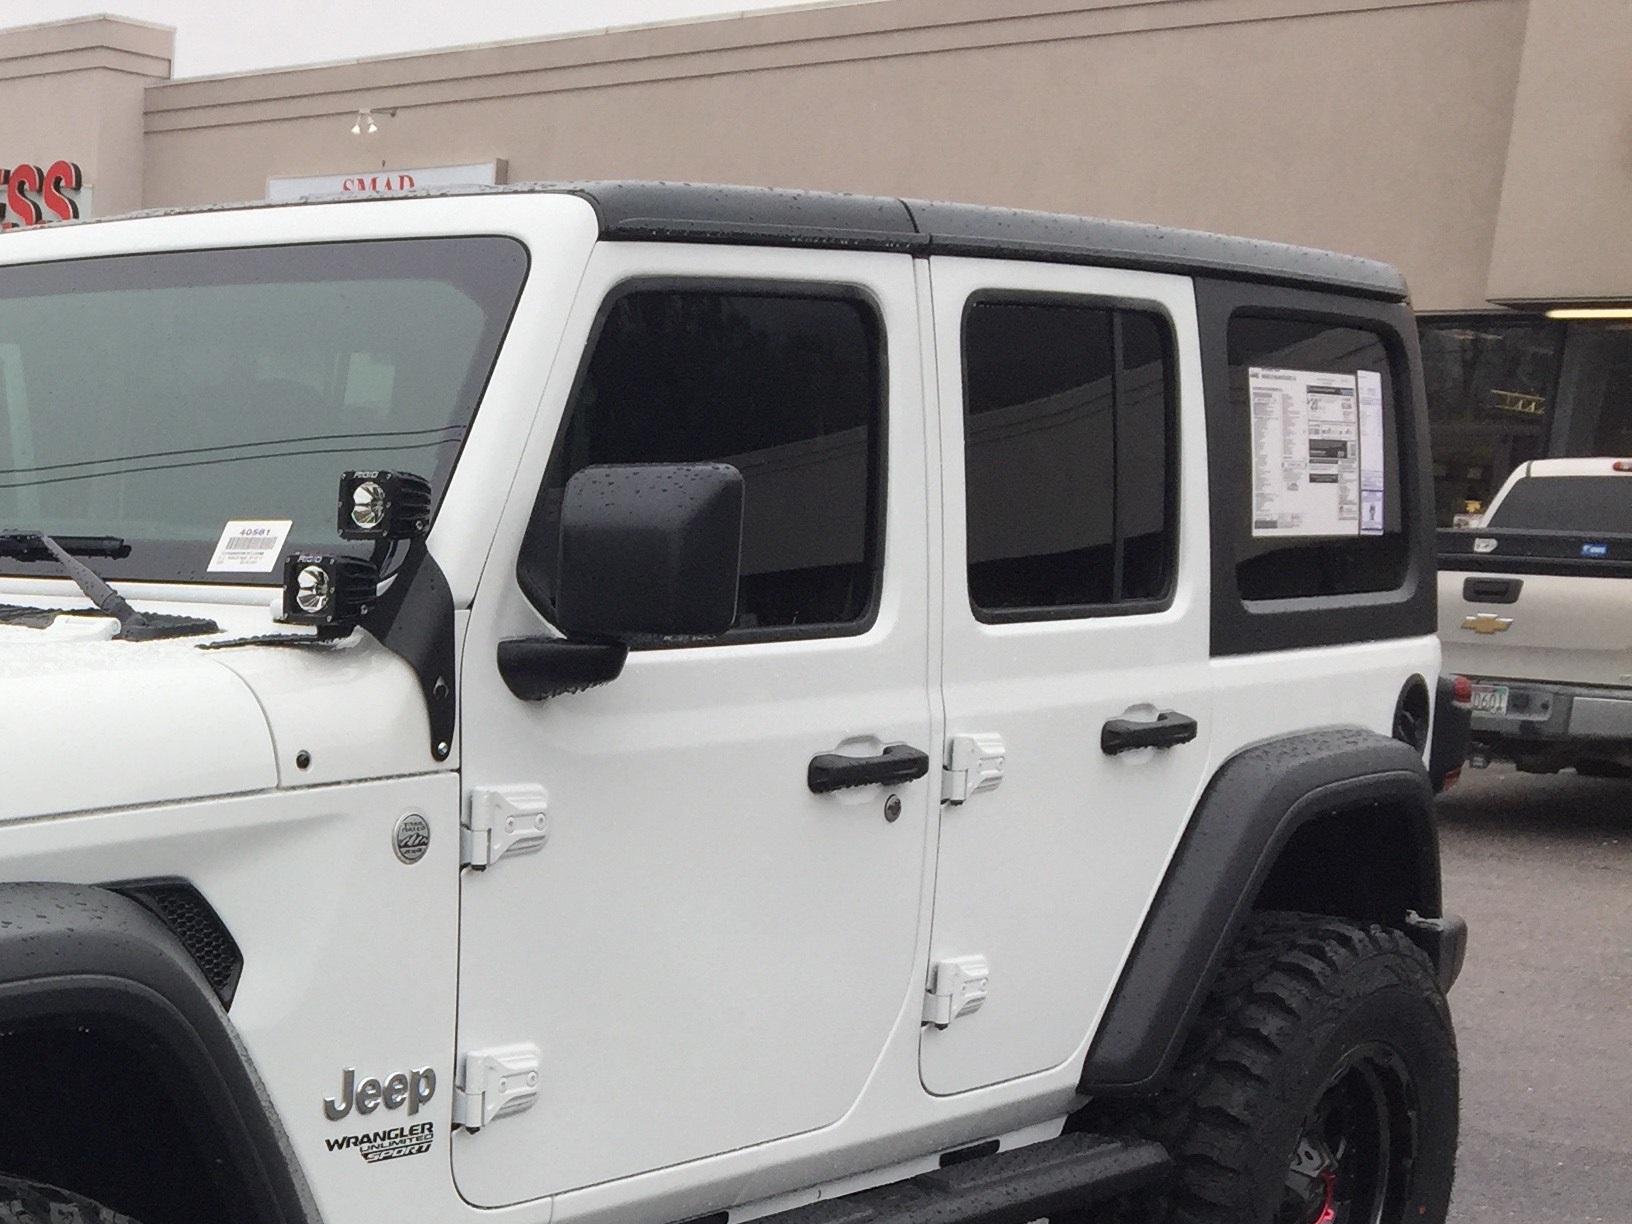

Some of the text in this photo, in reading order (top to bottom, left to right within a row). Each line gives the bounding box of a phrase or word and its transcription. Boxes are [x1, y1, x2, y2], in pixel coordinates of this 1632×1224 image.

[323, 1066, 437, 1122] Jeep
[325, 1121, 434, 1152] WRANGLER
[359, 1133, 434, 1153] UNLIMITED
[366, 1143, 432, 1162] SPORT
